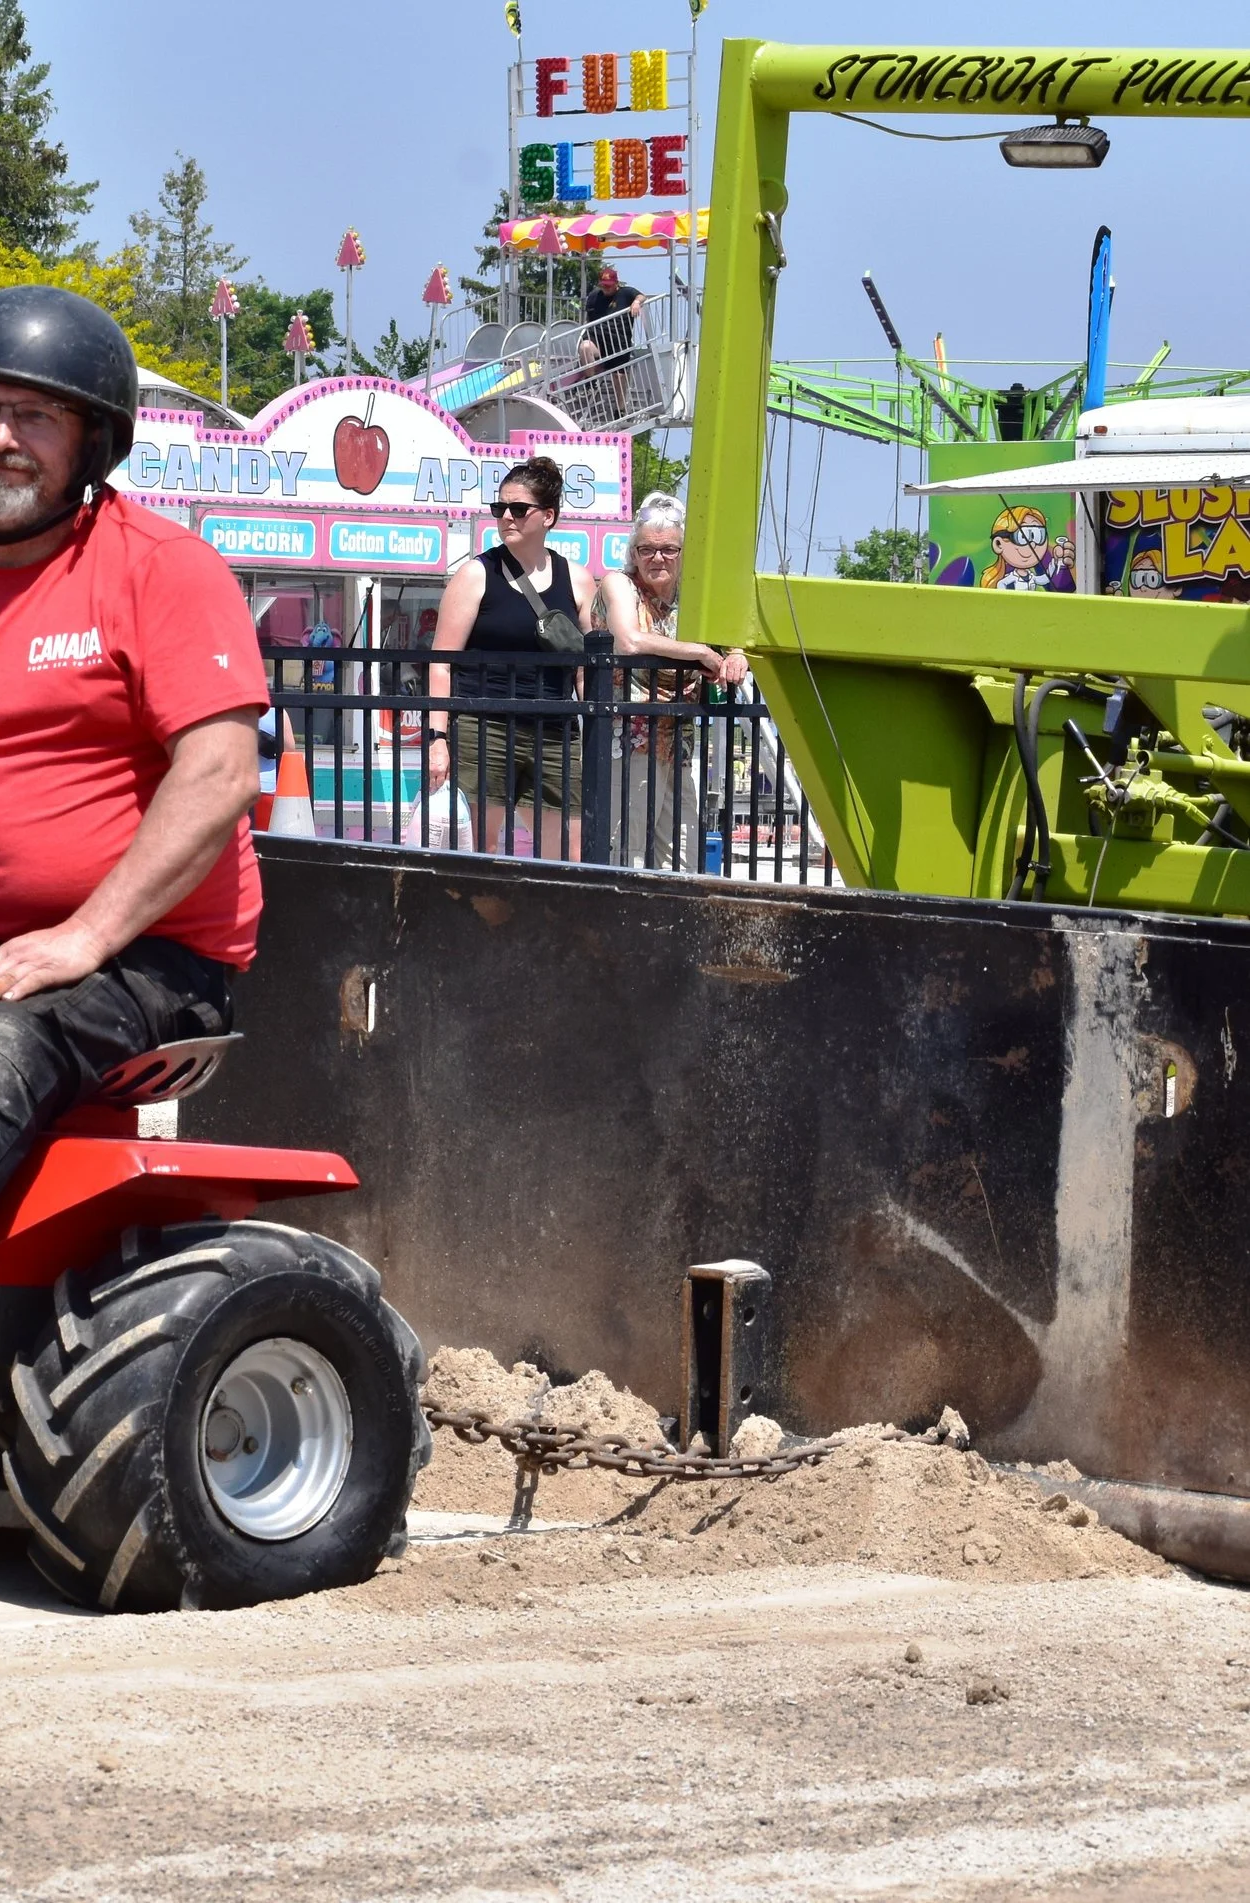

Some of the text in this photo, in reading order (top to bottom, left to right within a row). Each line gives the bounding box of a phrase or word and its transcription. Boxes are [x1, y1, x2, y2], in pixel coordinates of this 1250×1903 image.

[535, 49, 668, 117] FUN
[814, 54, 1250, 106] STONEBOAT PULLE
[519, 135, 686, 202] SLIDE
[127, 441, 596, 509] CANDY APPS
[212, 529, 305, 553] POPCORN
[339, 527, 434, 561] Cotton Candy
[28, 626, 103, 665] CANADA
